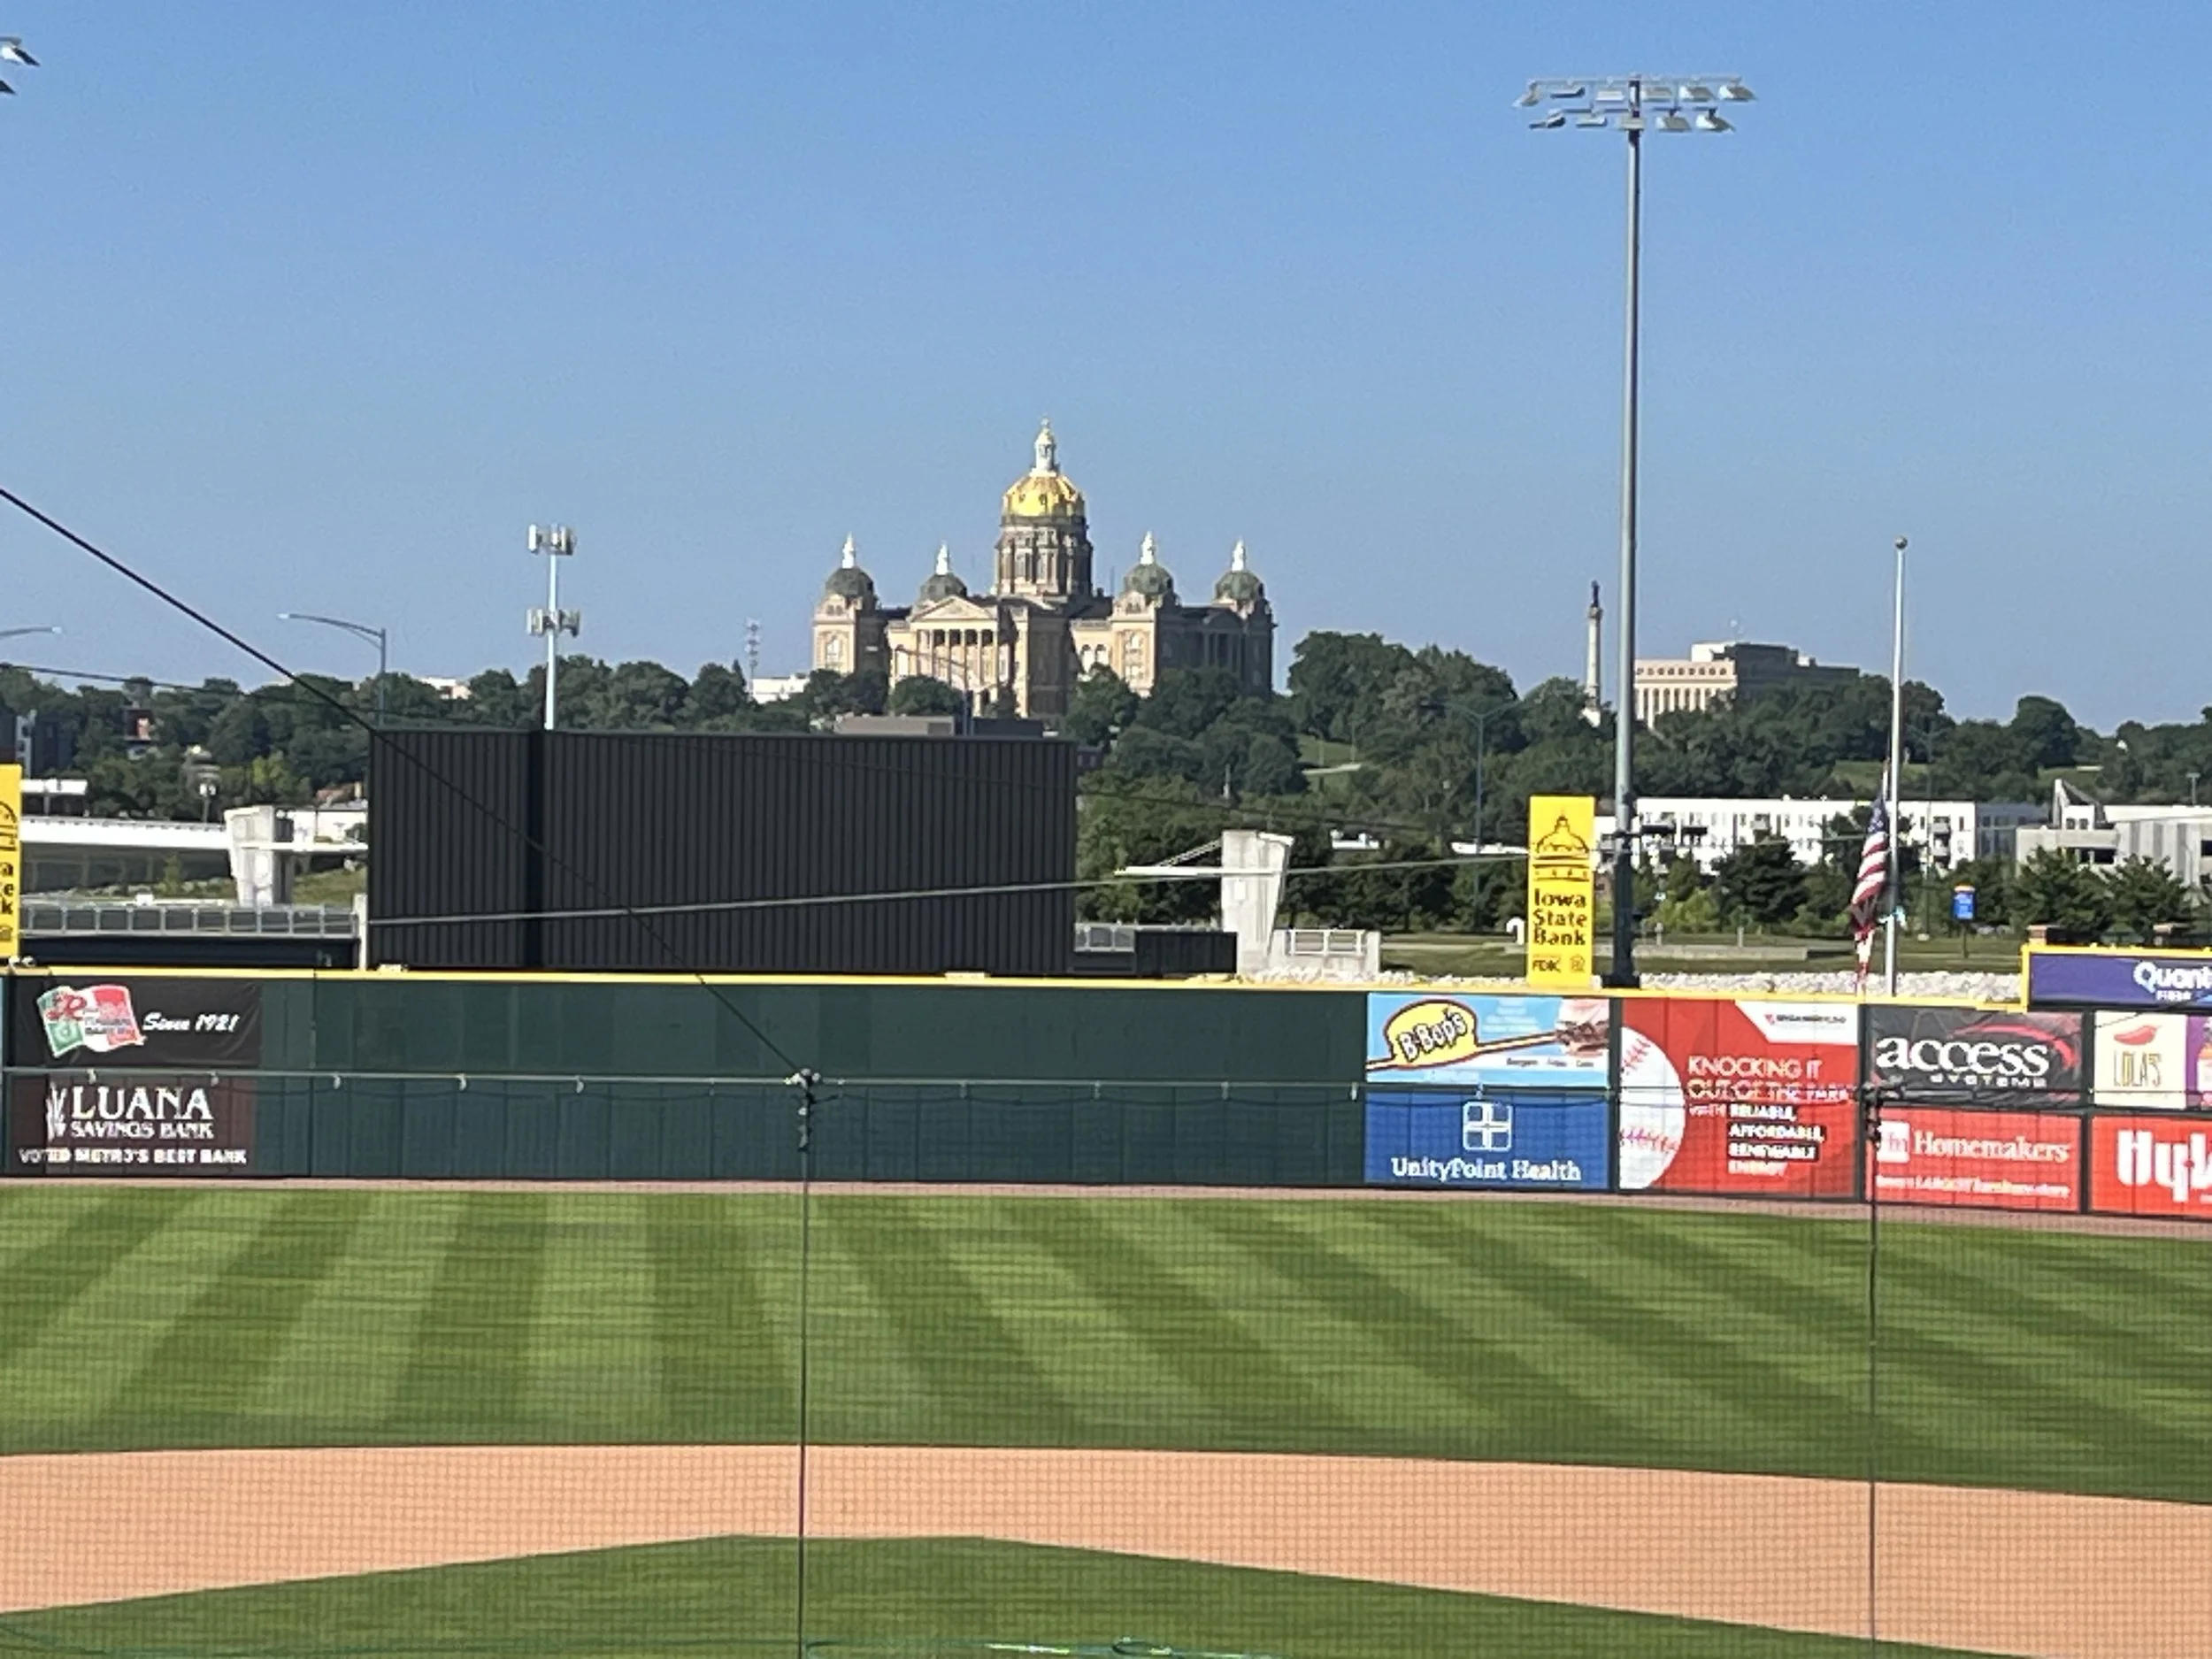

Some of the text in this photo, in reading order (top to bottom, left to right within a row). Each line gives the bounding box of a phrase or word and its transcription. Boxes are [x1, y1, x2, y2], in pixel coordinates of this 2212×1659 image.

[1533, 887, 1586, 909] Iowa
[1532, 908, 1588, 928] State
[1532, 924, 1586, 946] Bank
[142, 1011, 191, 1031] Since
[194, 1014, 240, 1033] 1921
[1688, 1055, 1823, 1079] KNOCKING IT
[1876, 1037, 2049, 1077] access
[71, 1086, 214, 1120] LUANA
[71, 1122, 214, 1140] SAVINGS BANK
[19, 1148, 72, 1164] VOTED
[153, 1148, 197, 1164] BEST
[200, 1148, 248, 1165] BANK
[1914, 1130, 2070, 1163] Homemakers
[1391, 1157, 1582, 1182] UnityPoint Health
